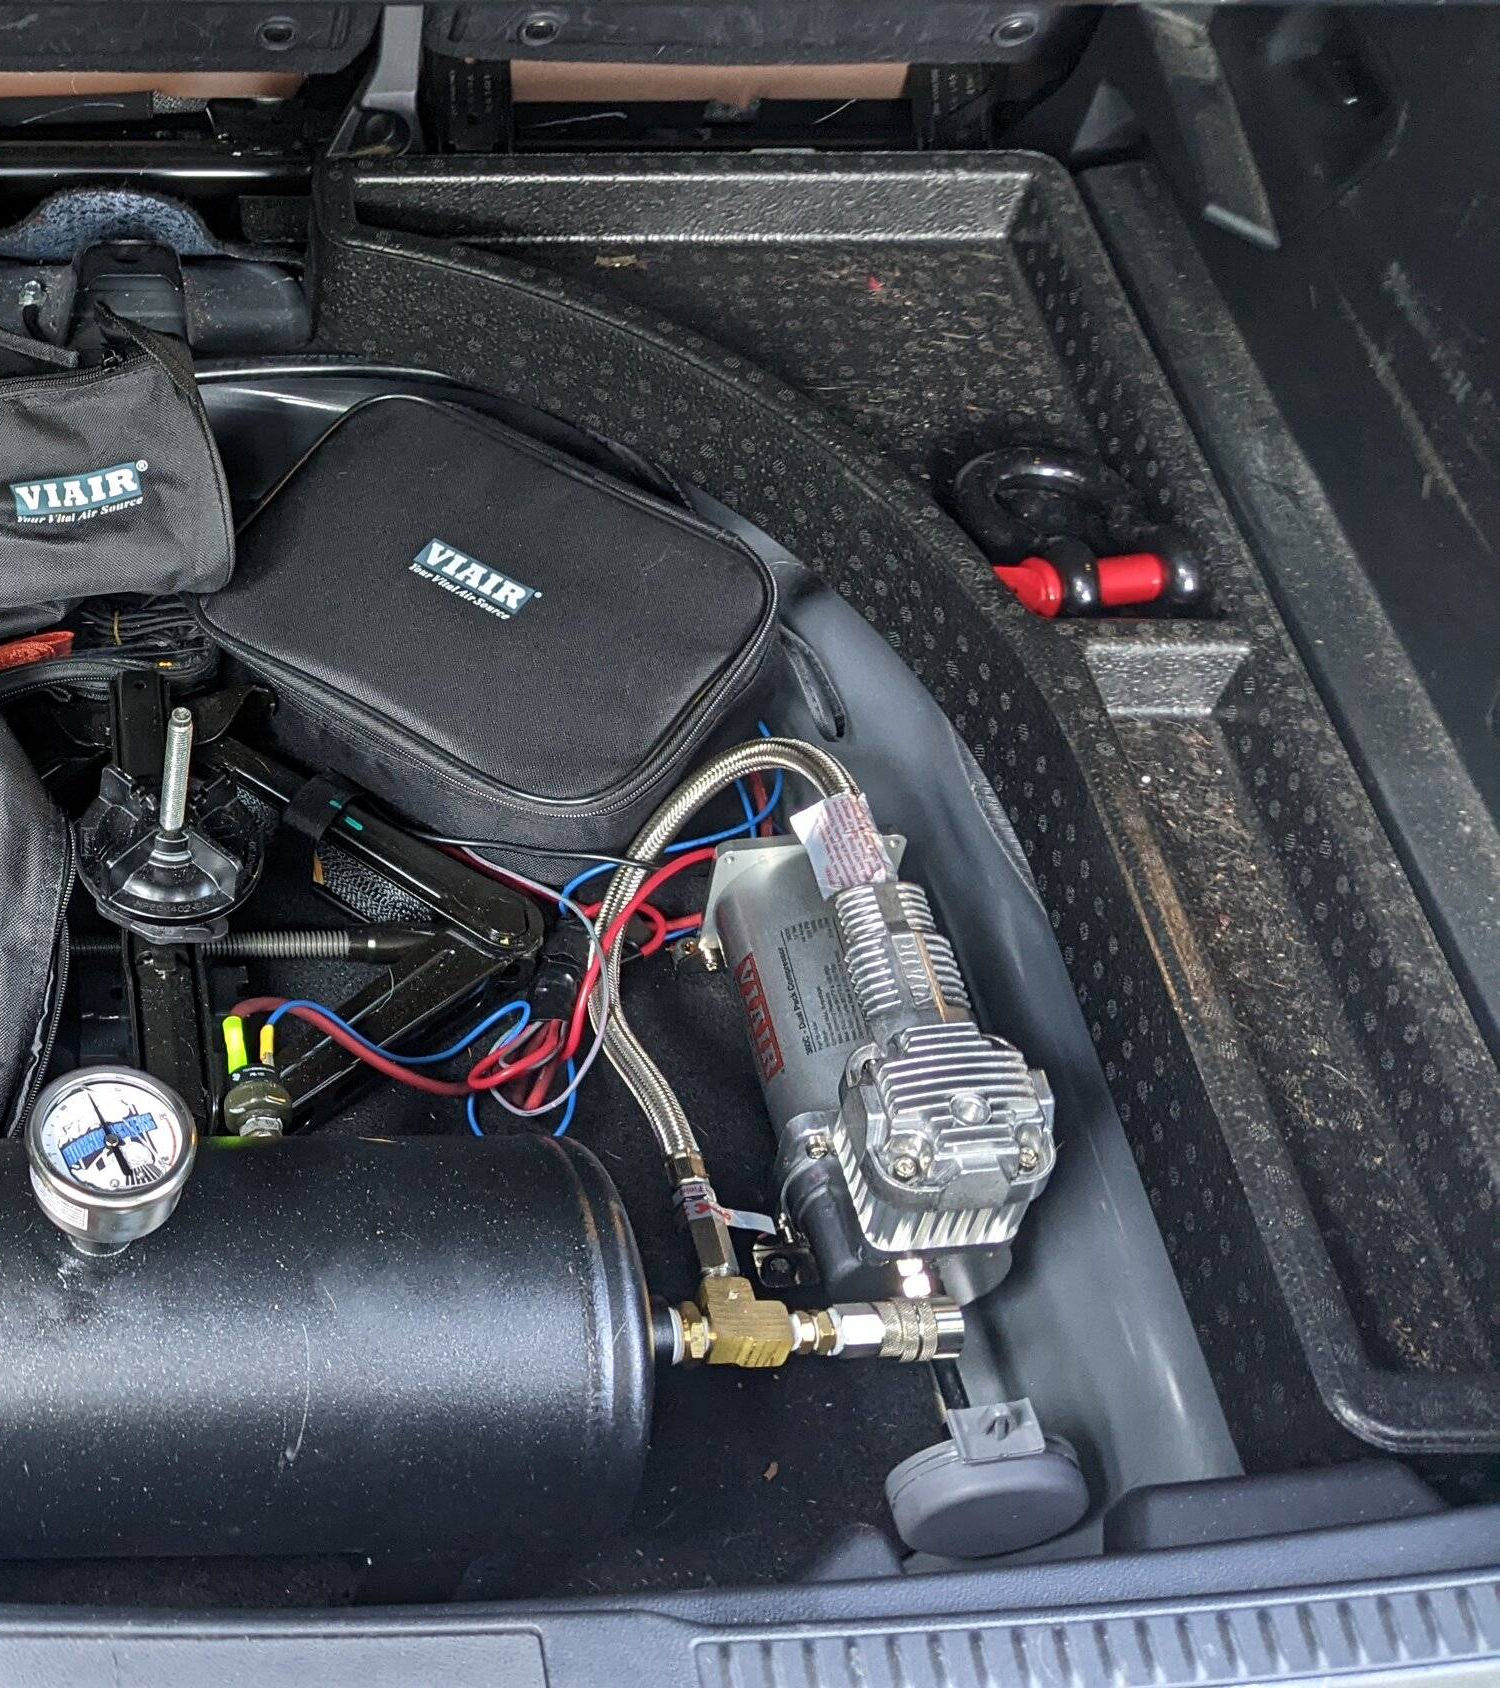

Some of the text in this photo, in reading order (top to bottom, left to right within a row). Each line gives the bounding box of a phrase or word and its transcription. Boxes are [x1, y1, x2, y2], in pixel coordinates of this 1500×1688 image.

[15, 468, 138, 510] VIAIR
[17, 497, 143, 524] Your Vital Air Source
[408, 562, 510, 620] Your Vital Air Source
[426, 542, 526, 610] VIAIR
[739, 958, 778, 1079] VIAIR
